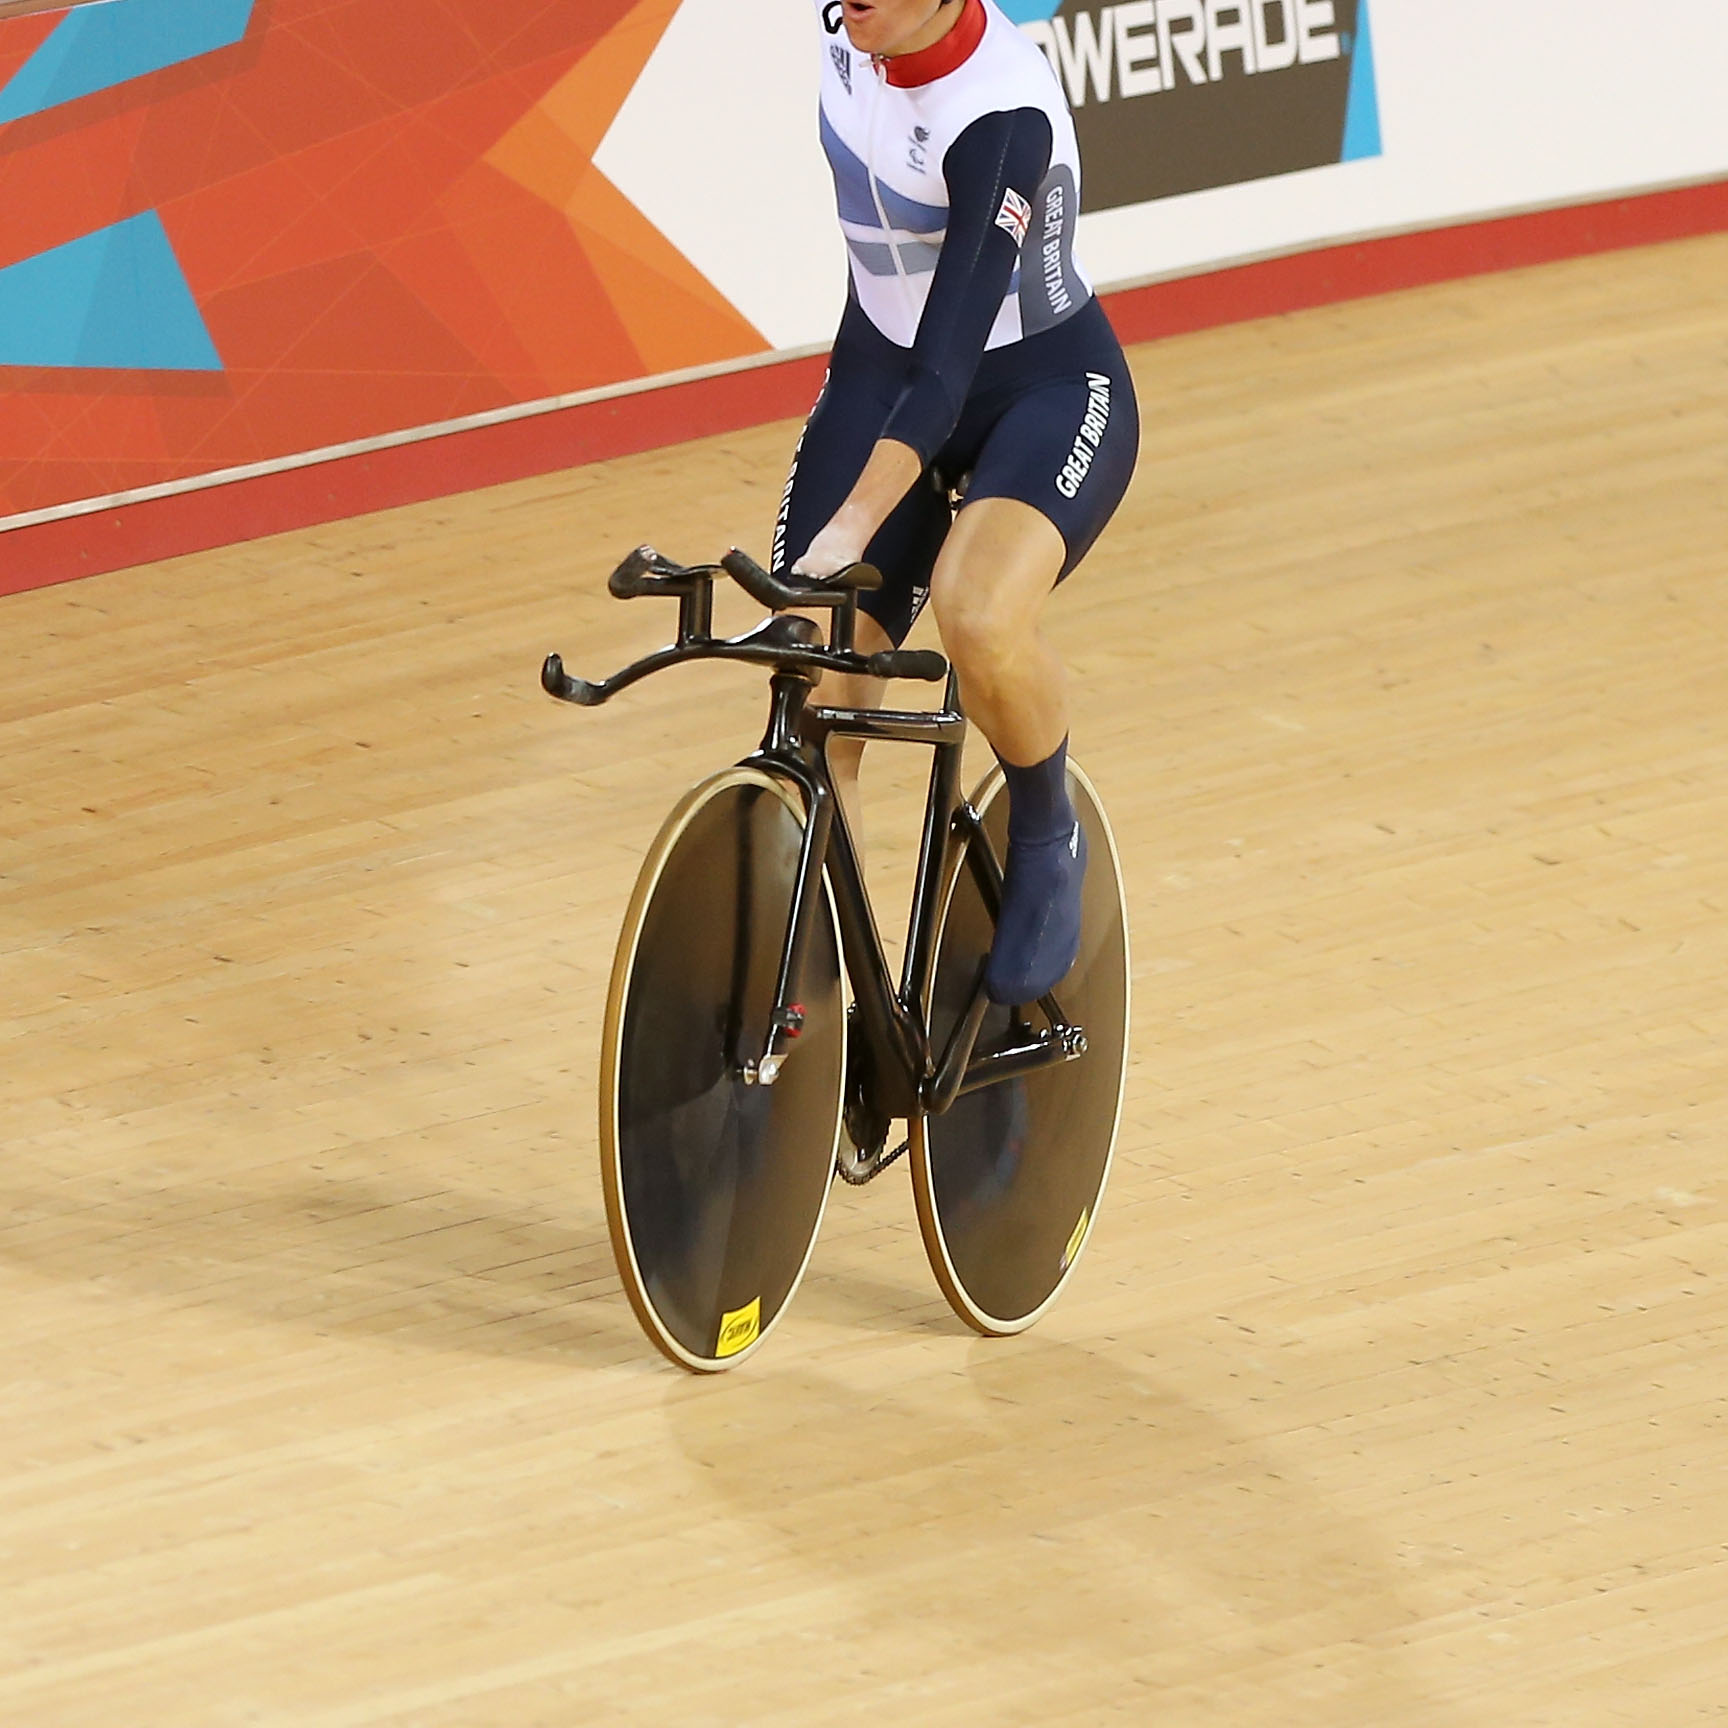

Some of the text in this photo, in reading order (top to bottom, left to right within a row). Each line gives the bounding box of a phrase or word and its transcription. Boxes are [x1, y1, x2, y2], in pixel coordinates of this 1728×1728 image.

[1042, 185, 1073, 315] GREAT BRITAIN
[1055, 372, 1111, 499] GREAT BRITAIN
